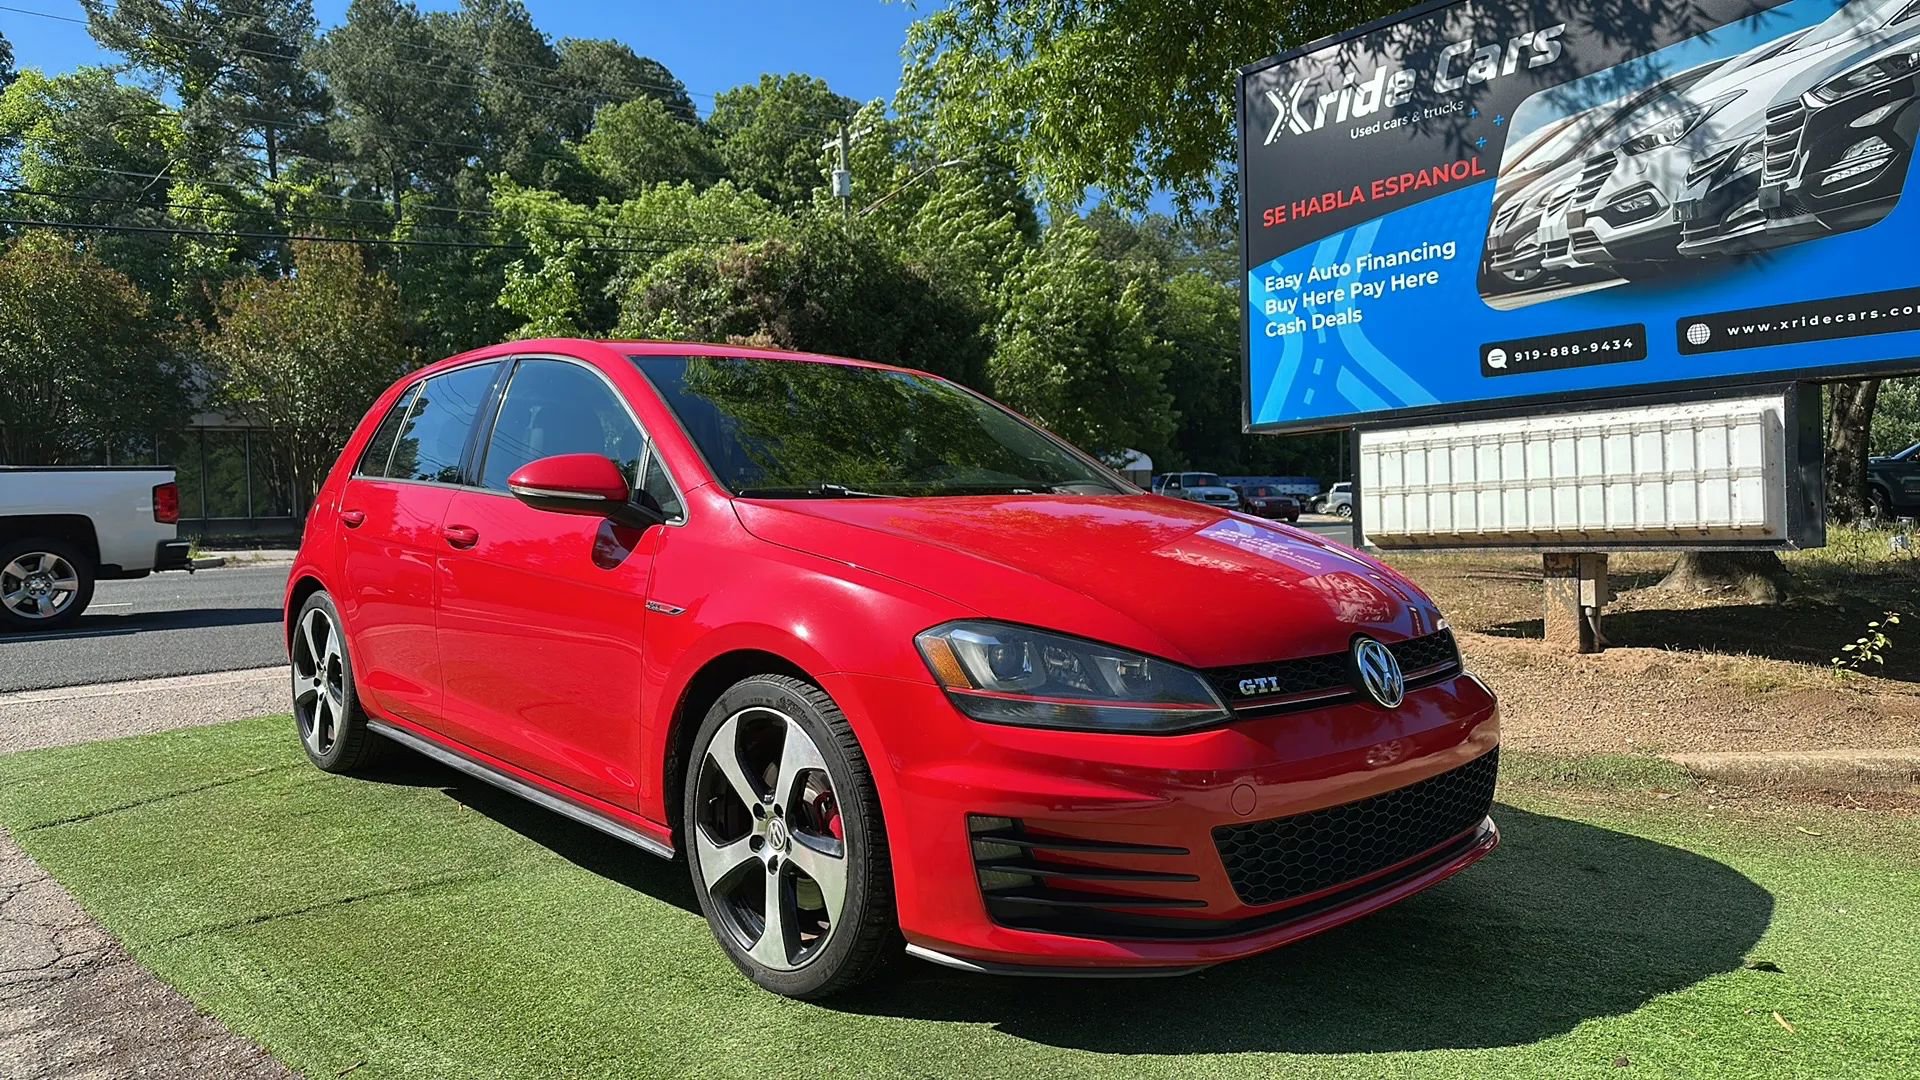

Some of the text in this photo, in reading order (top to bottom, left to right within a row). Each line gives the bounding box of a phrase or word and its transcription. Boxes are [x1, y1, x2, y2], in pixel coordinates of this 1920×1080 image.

[1264, 23, 1566, 145] Xride Cars
[1351, 100, 1464, 139] Used cars & trucks
[1263, 157, 1486, 228] SE HABLA ESPANOL
[1265, 241, 1456, 292] Easy Auto Financing
[1265, 271, 1439, 315] Buy Here Pay Here
[1265, 307, 1363, 337] Cash Deals
[1727, 304, 1920, 336] www.xridecars.co
[1513, 338, 1634, 363] 919-888-9434
[1238, 676, 1281, 696] GTI
